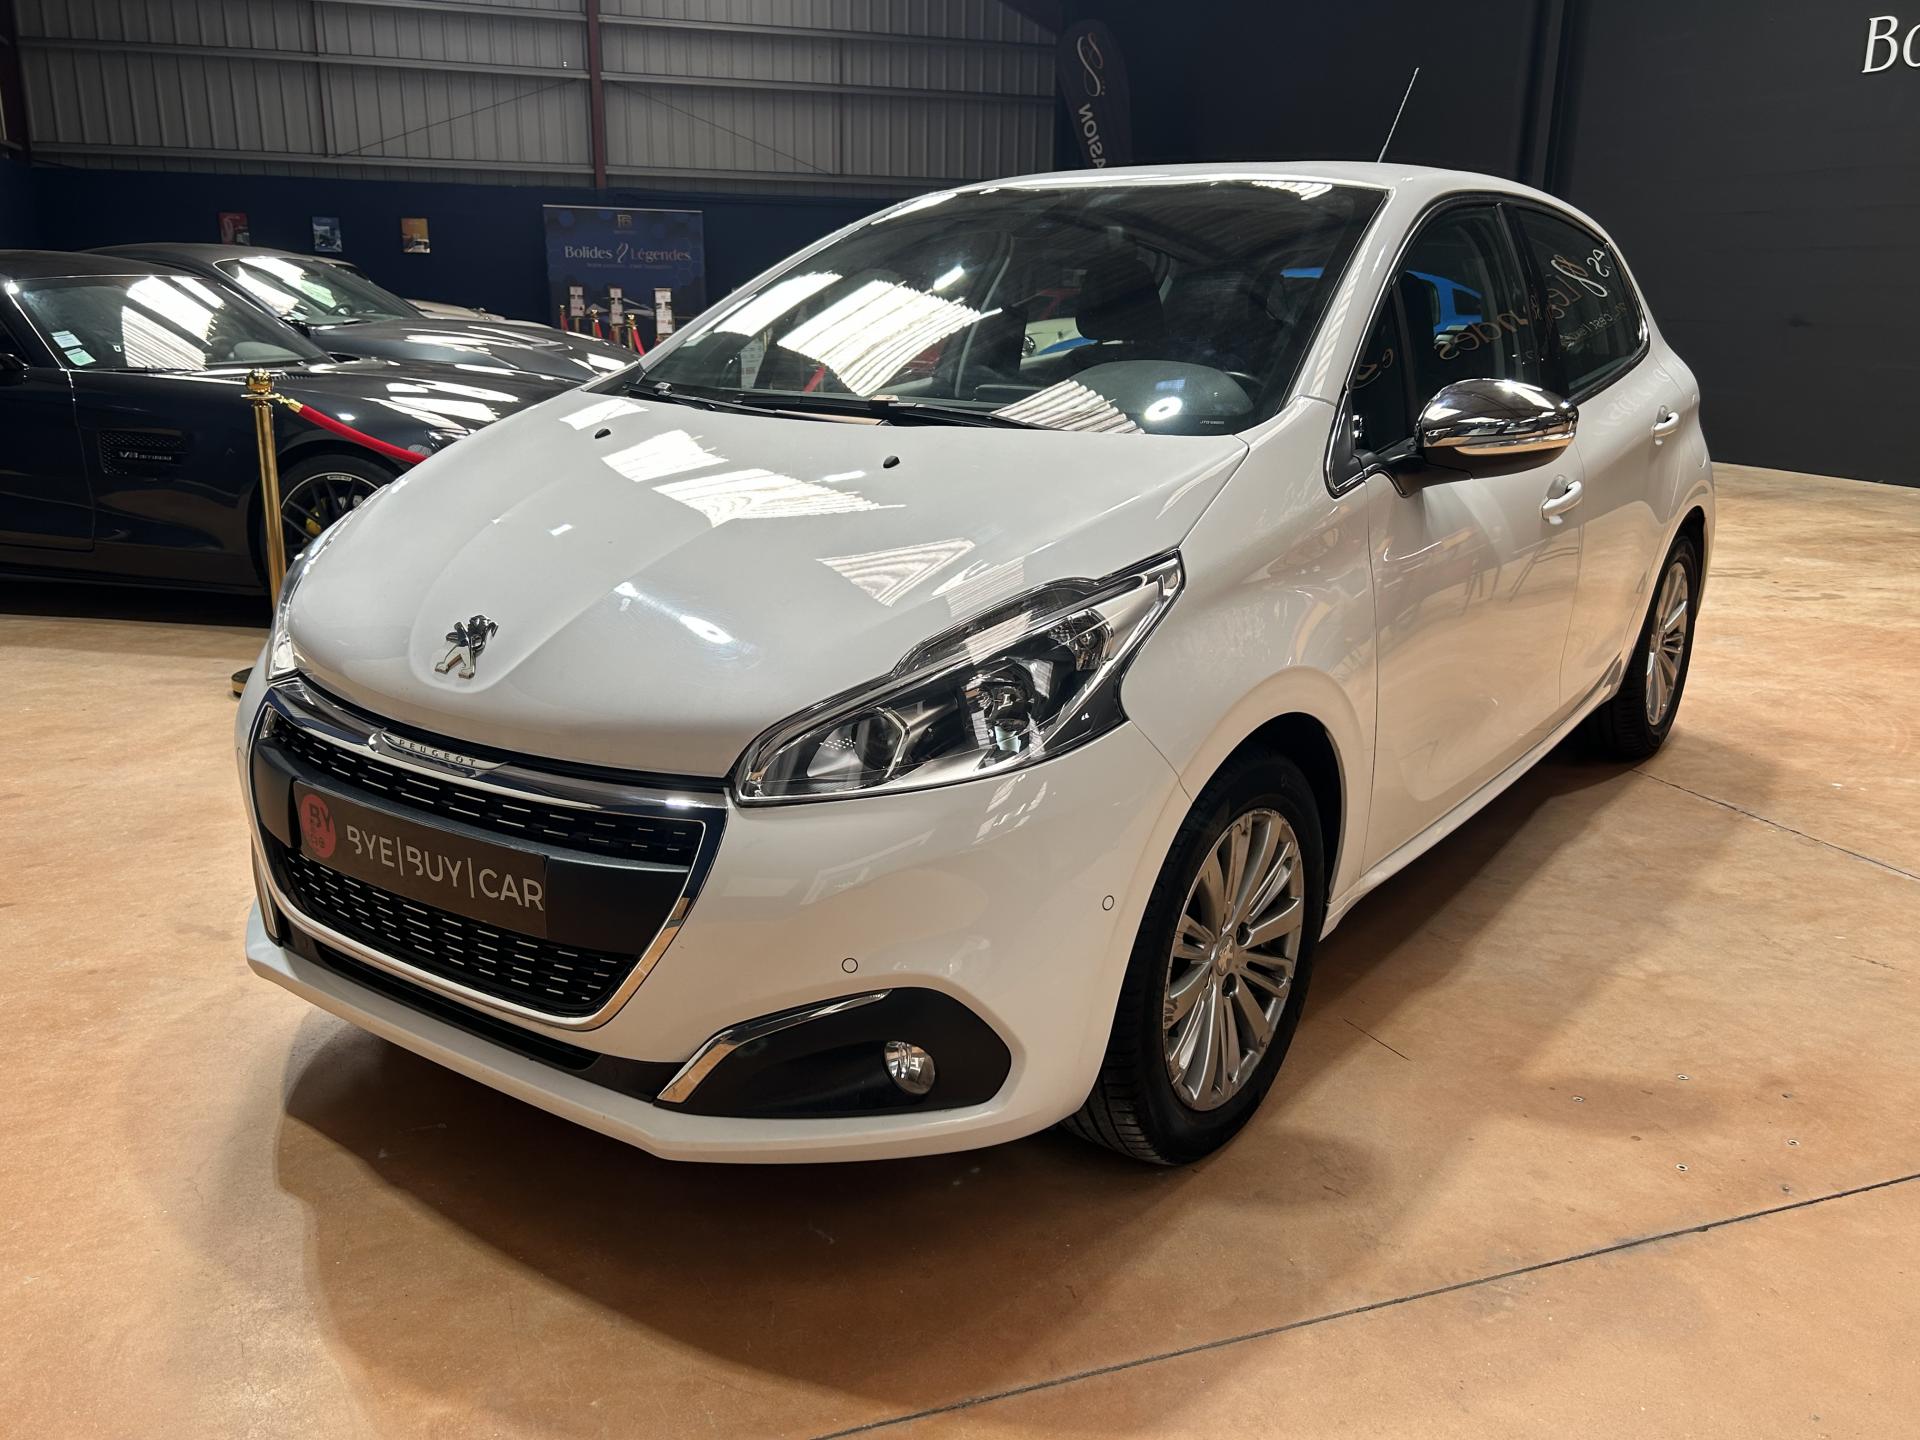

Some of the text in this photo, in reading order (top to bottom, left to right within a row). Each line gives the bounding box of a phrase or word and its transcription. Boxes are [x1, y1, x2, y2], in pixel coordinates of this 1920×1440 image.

[564, 245, 691, 263] Bolides Légendes
[399, 739, 476, 767] PEUGEOT
[478, 868, 545, 911] CAR
